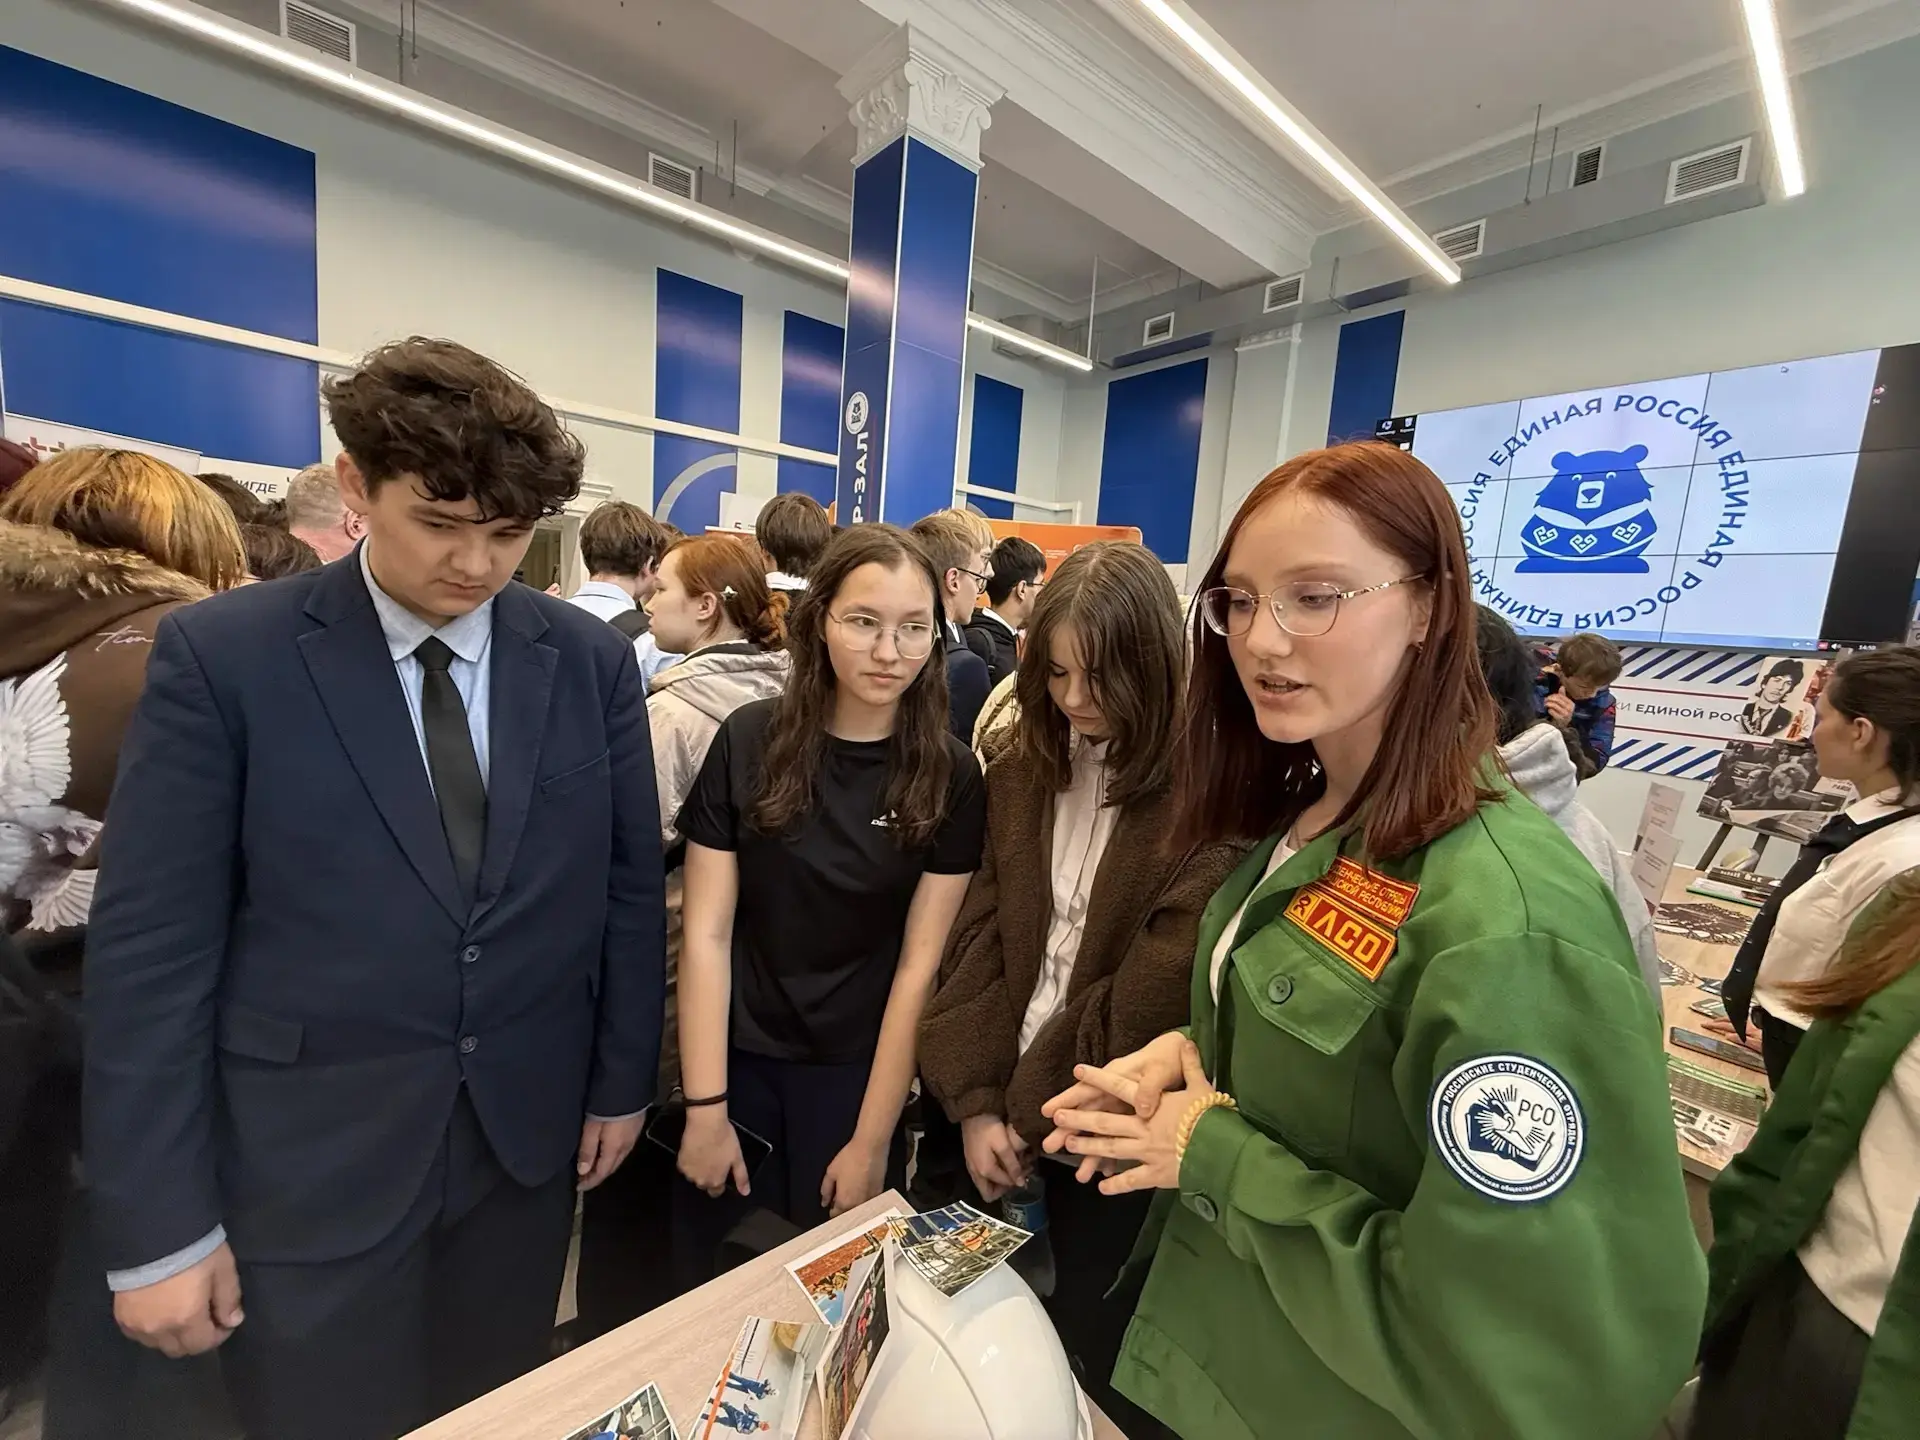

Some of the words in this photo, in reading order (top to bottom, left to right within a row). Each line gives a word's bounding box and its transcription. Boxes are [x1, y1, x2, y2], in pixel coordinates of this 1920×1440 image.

[1489, 397, 1602, 466] ЕДИНАЯ
[1613, 394, 1733, 449] РОССИЯ
[236, 480, 277, 494] ИГДЕ
[1697, 450, 1750, 568] ЕДИНАЯ
[1471, 569, 1563, 628] ЕДИНАЯ
[1574, 571, 1703, 629] РОССИЯ
[1636, 704, 1704, 719] ЕДИНОЙ
[1443, 1063, 1495, 1104] РОССИЙСКИЕ
[1498, 1062, 1566, 1103] СТУДЕНЧЕСКИЕ
[1563, 1104, 1578, 1146] ОТРЯДЫ
[1518, 1099, 1556, 1126] РСО
